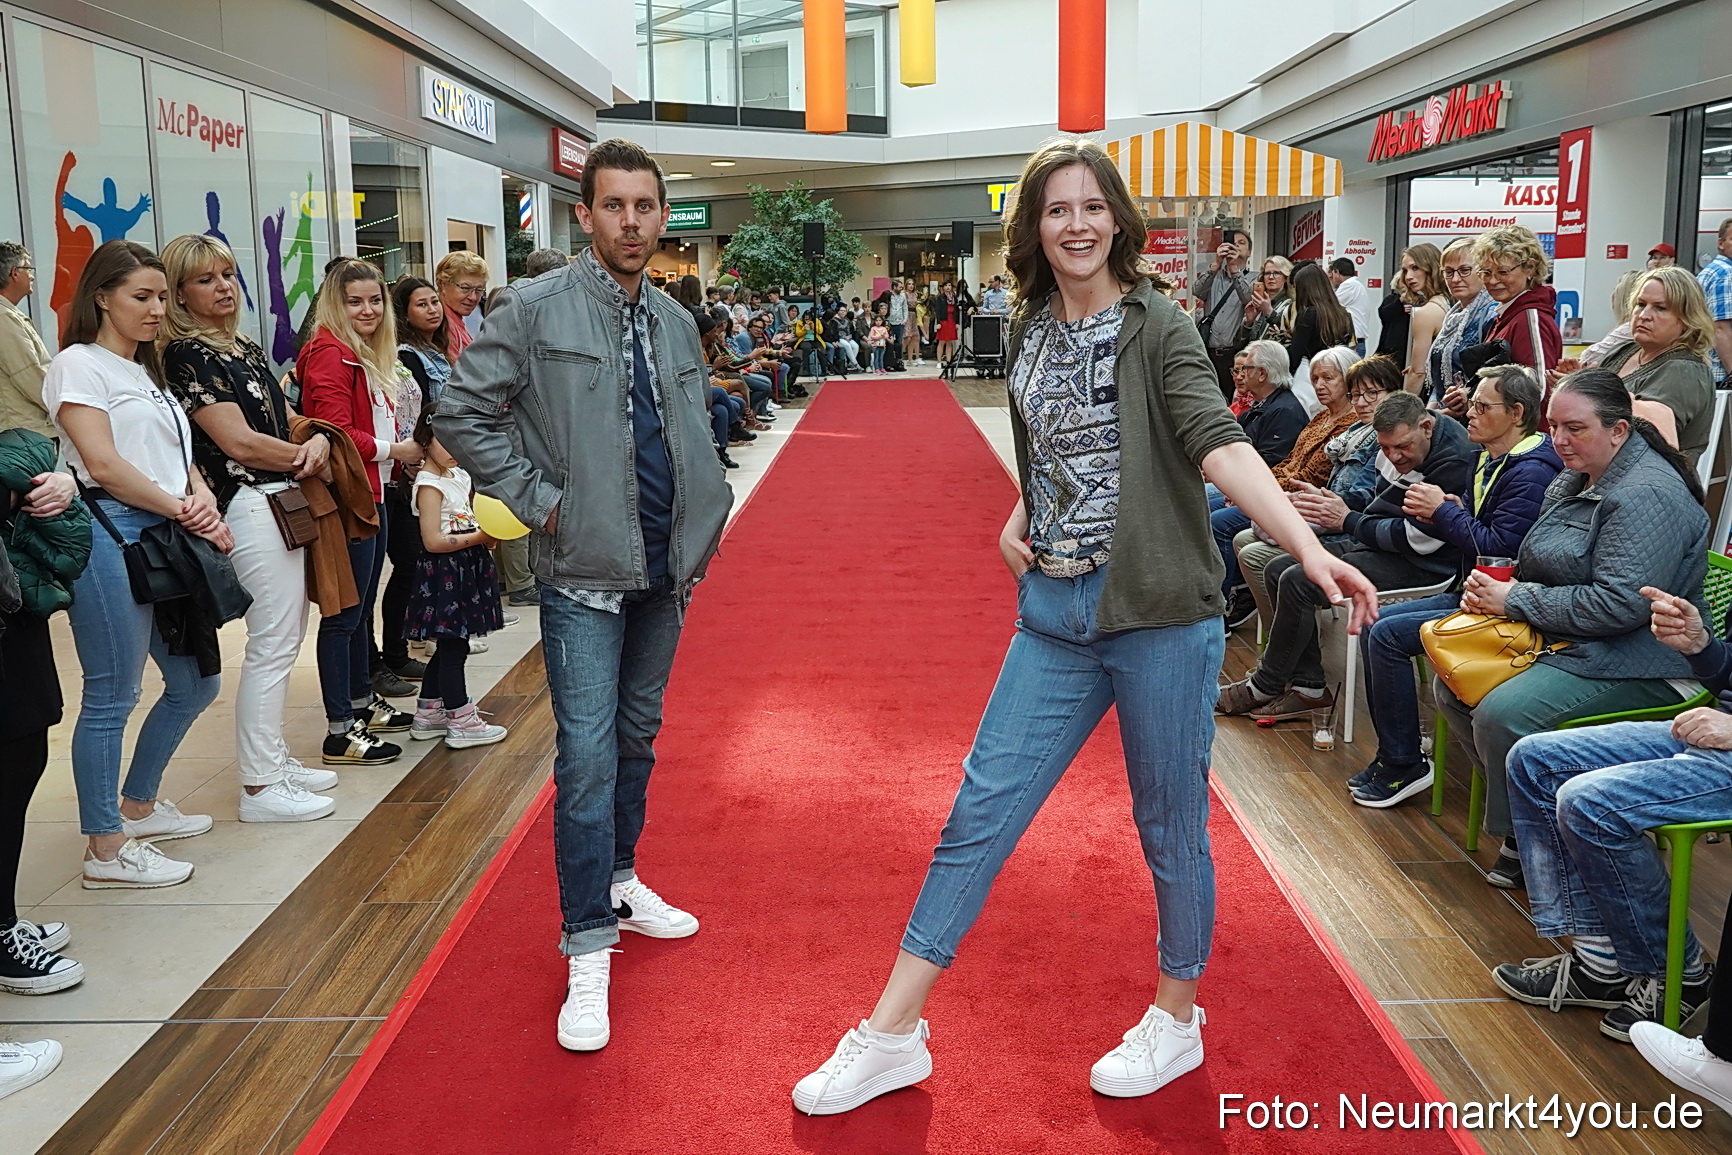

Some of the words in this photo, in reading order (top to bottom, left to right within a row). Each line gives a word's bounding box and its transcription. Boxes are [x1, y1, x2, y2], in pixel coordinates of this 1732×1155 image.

[157, 97, 244, 153] McPaper
[432, 78, 492, 135] STARCUT
[1567, 139, 1584, 203] 1
[1504, 185, 1558, 206] KASS
[668, 212, 702, 222] ENSRAUM
[1293, 209, 1322, 251] Service
[1344, 247, 1377, 255] Abholung
